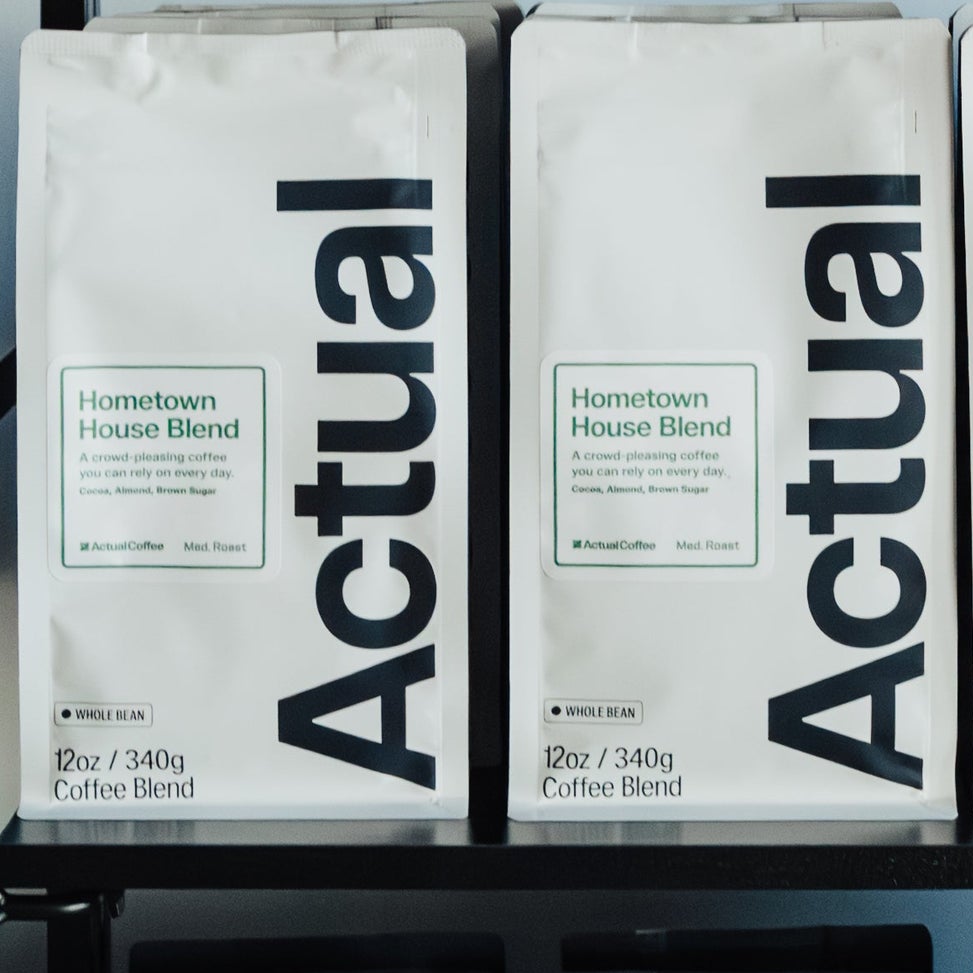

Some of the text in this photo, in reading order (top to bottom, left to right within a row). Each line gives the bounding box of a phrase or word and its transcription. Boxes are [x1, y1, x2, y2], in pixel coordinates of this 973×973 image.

[79, 391, 216, 411] Hometown
[571, 386, 708, 409] Hometown
[79, 417, 239, 439] House Blend
[571, 415, 731, 438] House Blend
[570, 449, 719, 463] A crowd-pleasing coffee
[571, 467, 594, 479] you
[596, 467, 619, 477] can
[621, 466, 644, 479] rely
[647, 468, 663, 476] on
[665, 467, 699, 479] every
[766, 175, 926, 790] Actual
[277, 179, 436, 790] Actual
[212, 540, 246, 552] Roast
[705, 540, 739, 551] Roast
[75, 708, 144, 721] WHOLE BEAN
[565, 705, 635, 718] WHOLE BEAN
[54, 747, 100, 772] 12oz
[125, 748, 184, 775] 340g
[543, 744, 590, 770] 12oz
[614, 746, 673, 773] 340g
[53, 776, 194, 800] Coffee Blend
[542, 775, 682, 799] Coffee Blend
